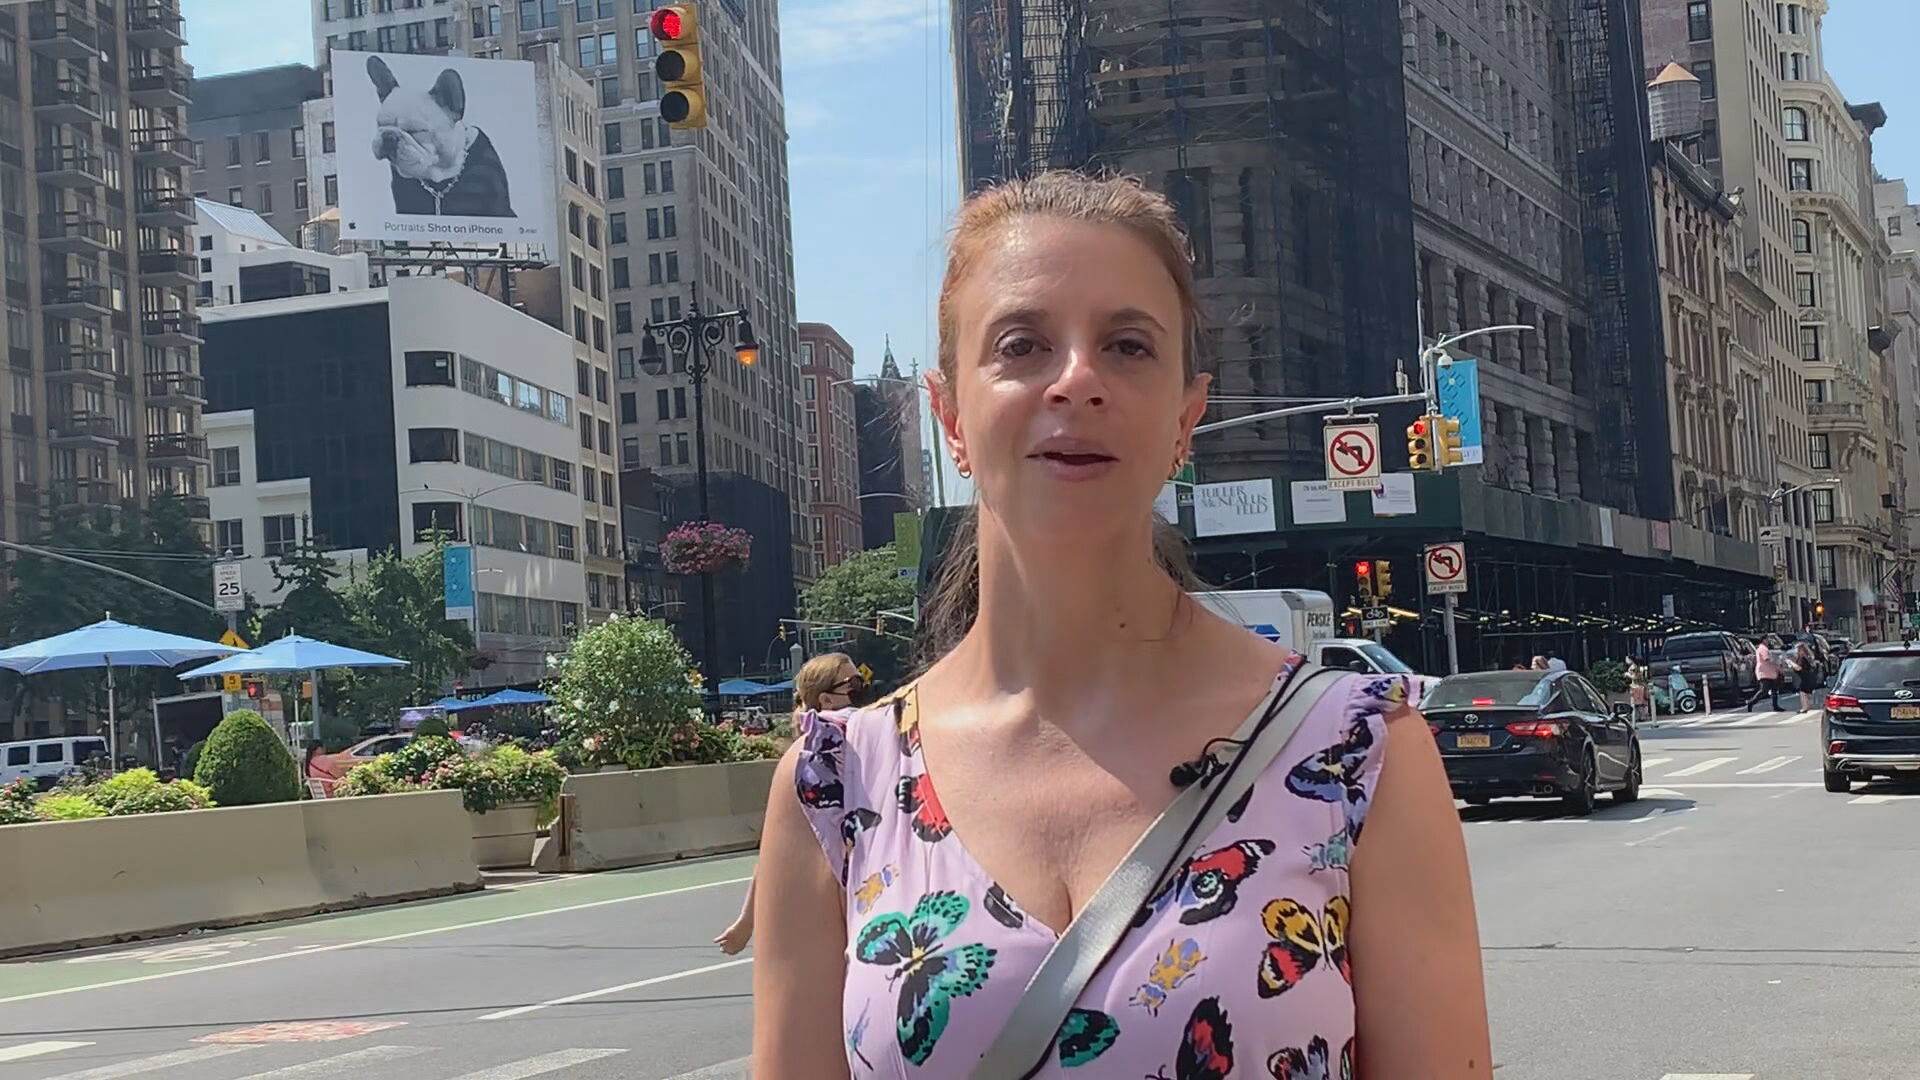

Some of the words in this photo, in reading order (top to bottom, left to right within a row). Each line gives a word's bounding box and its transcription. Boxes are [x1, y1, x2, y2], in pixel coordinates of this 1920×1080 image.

[384, 221, 425, 232] Portraits
[427, 223, 452, 234] Shot
[453, 225, 467, 233] on
[468, 225, 503, 234] iPhone
[219, 582, 240, 596] 25
[1306, 612, 1331, 627] PENSKE
